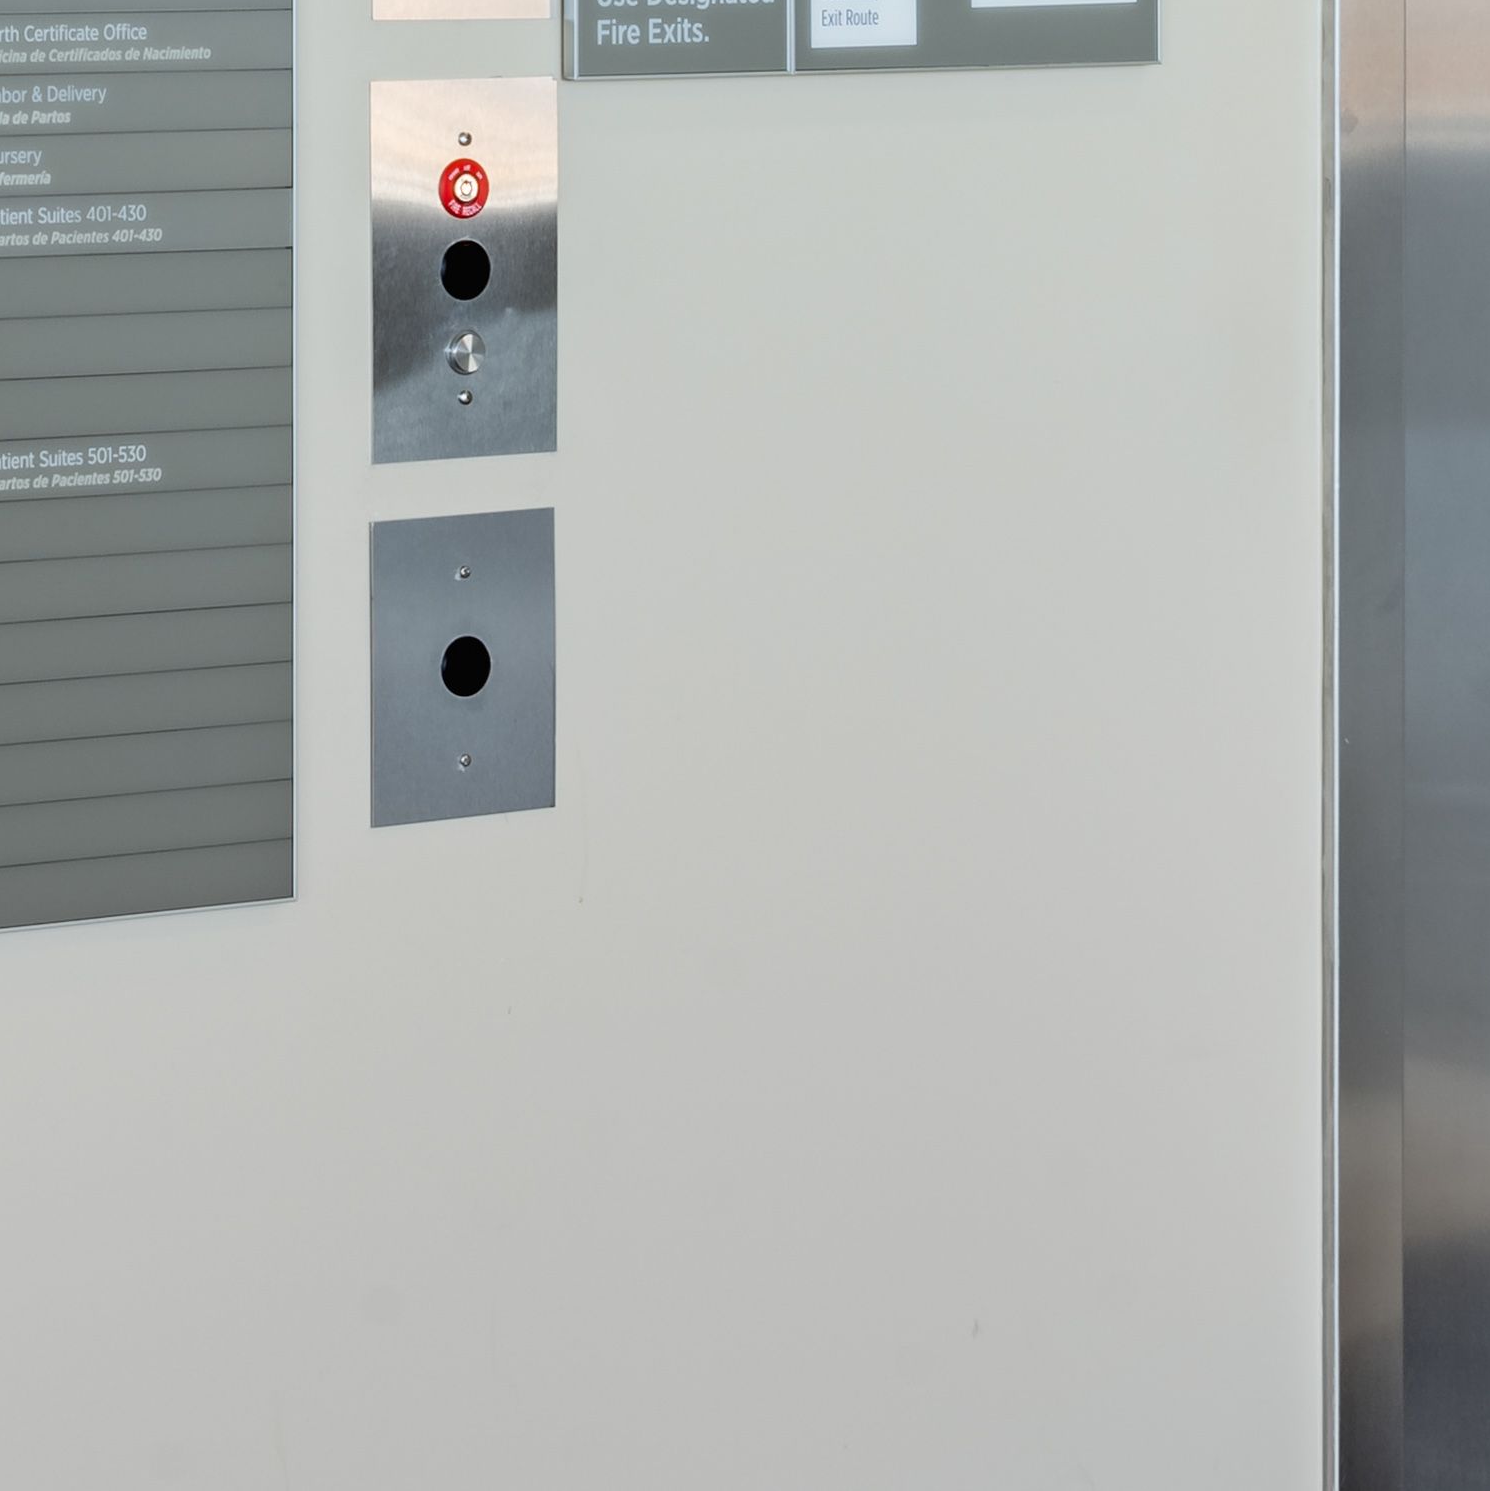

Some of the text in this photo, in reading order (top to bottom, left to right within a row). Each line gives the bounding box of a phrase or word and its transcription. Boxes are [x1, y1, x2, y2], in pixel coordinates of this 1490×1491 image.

[822, 9, 879, 26] Exit Route
[24, 24, 99, 42] Certificate
[104, 23, 147, 40] Office
[597, 17, 709, 45] Fire Exits.
[30, 49, 46, 62] de
[49, 48, 122, 62] Certificados
[125, 47, 140, 60] de
[143, 46, 211, 60] Nacimiento
[32, 86, 42, 102] &
[48, 85, 106, 104] Delivery
[12, 111, 28, 124] de
[31, 110, 71, 124] Partos
[38, 207, 81, 224] Suites
[86, 204, 146, 222] 401-430
[32, 232, 48, 245] de
[51, 230, 109, 244] Pacientes
[112, 228, 162, 242] 401-430
[40, 450, 83, 467] Suites
[88, 445, 146, 464] 501-530
[33, 475, 49, 488] de
[52, 472, 110, 487] Pacientes
[112, 468, 162, 483] 501-530
